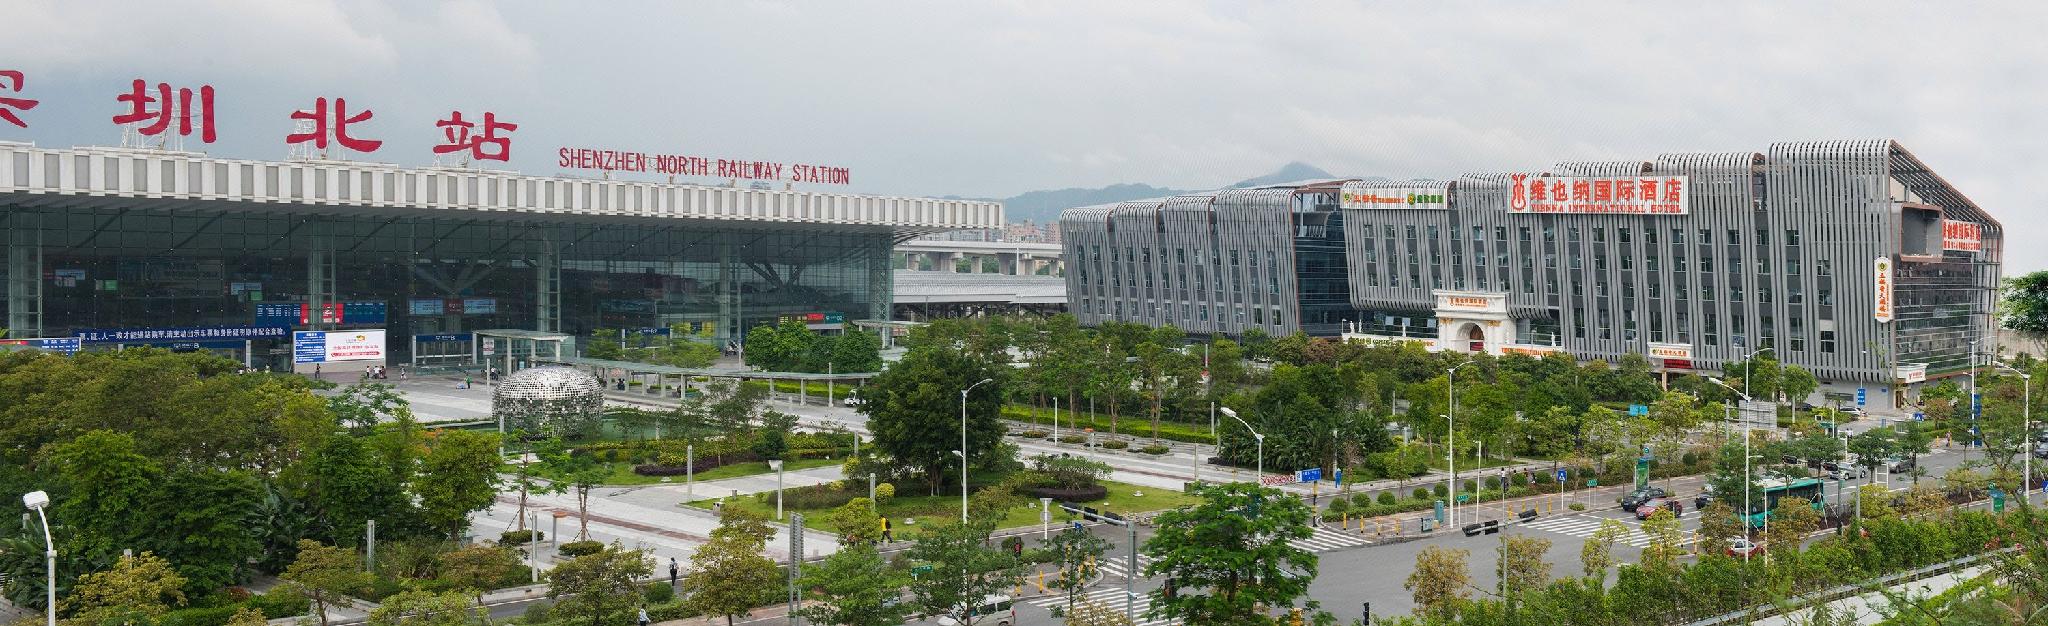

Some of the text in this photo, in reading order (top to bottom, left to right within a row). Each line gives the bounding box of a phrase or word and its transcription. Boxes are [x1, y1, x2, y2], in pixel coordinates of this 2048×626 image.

[559, 147, 849, 185] SHENZHEN NORTH RAILWAY STATION
[1530, 178, 1682, 203] 维也纳国际酒店
[1531, 204, 1682, 214] VIENNA INTERNATIONAL HOTEL
